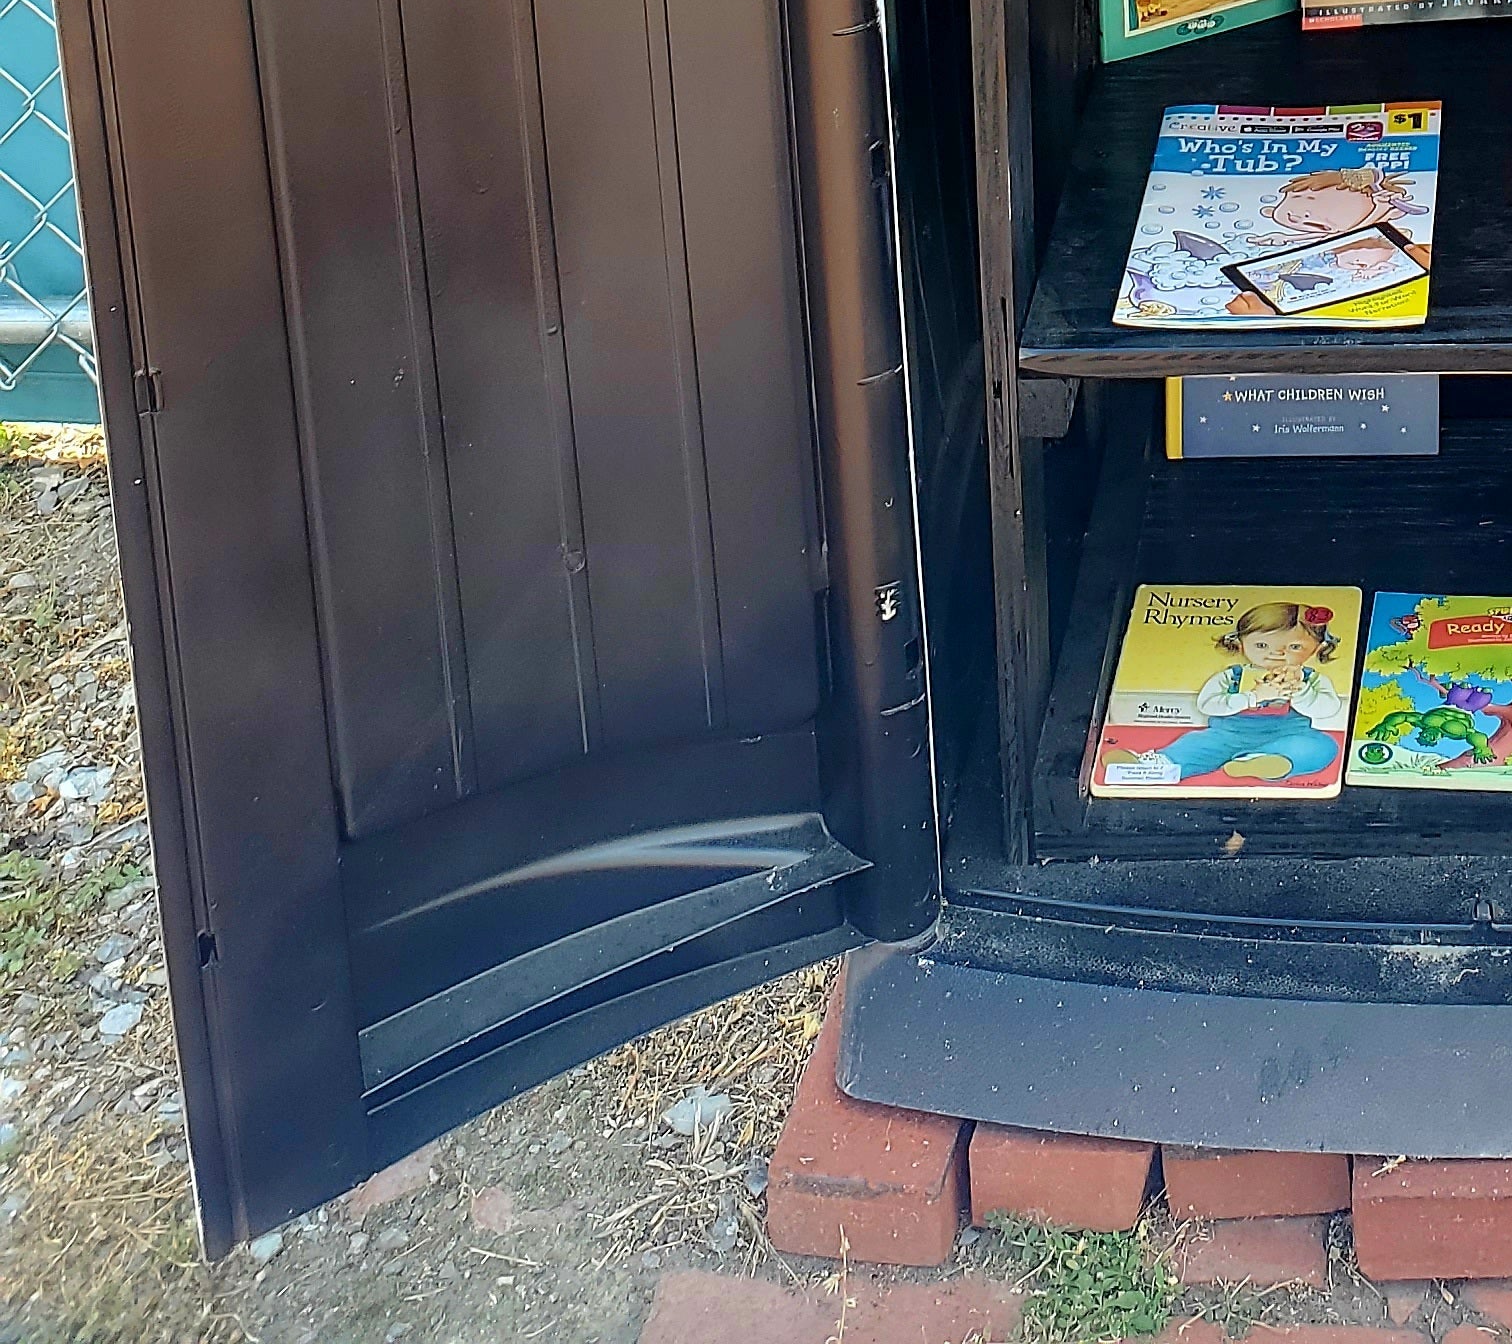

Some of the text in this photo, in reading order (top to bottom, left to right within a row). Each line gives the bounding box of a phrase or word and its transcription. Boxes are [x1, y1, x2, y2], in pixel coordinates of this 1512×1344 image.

[1392, 112, 1423, 130] $1
[1179, 138, 1338, 156] Who's In My
[1210, 155, 1303, 172] Tub?
[1365, 152, 1411, 161] FREE
[1235, 388, 1384, 403] WHAT CHILDREN WISH
[1147, 592, 1239, 612] Nursery
[1144, 609, 1235, 628] Rhymes
[1447, 620, 1504, 634] Ready
